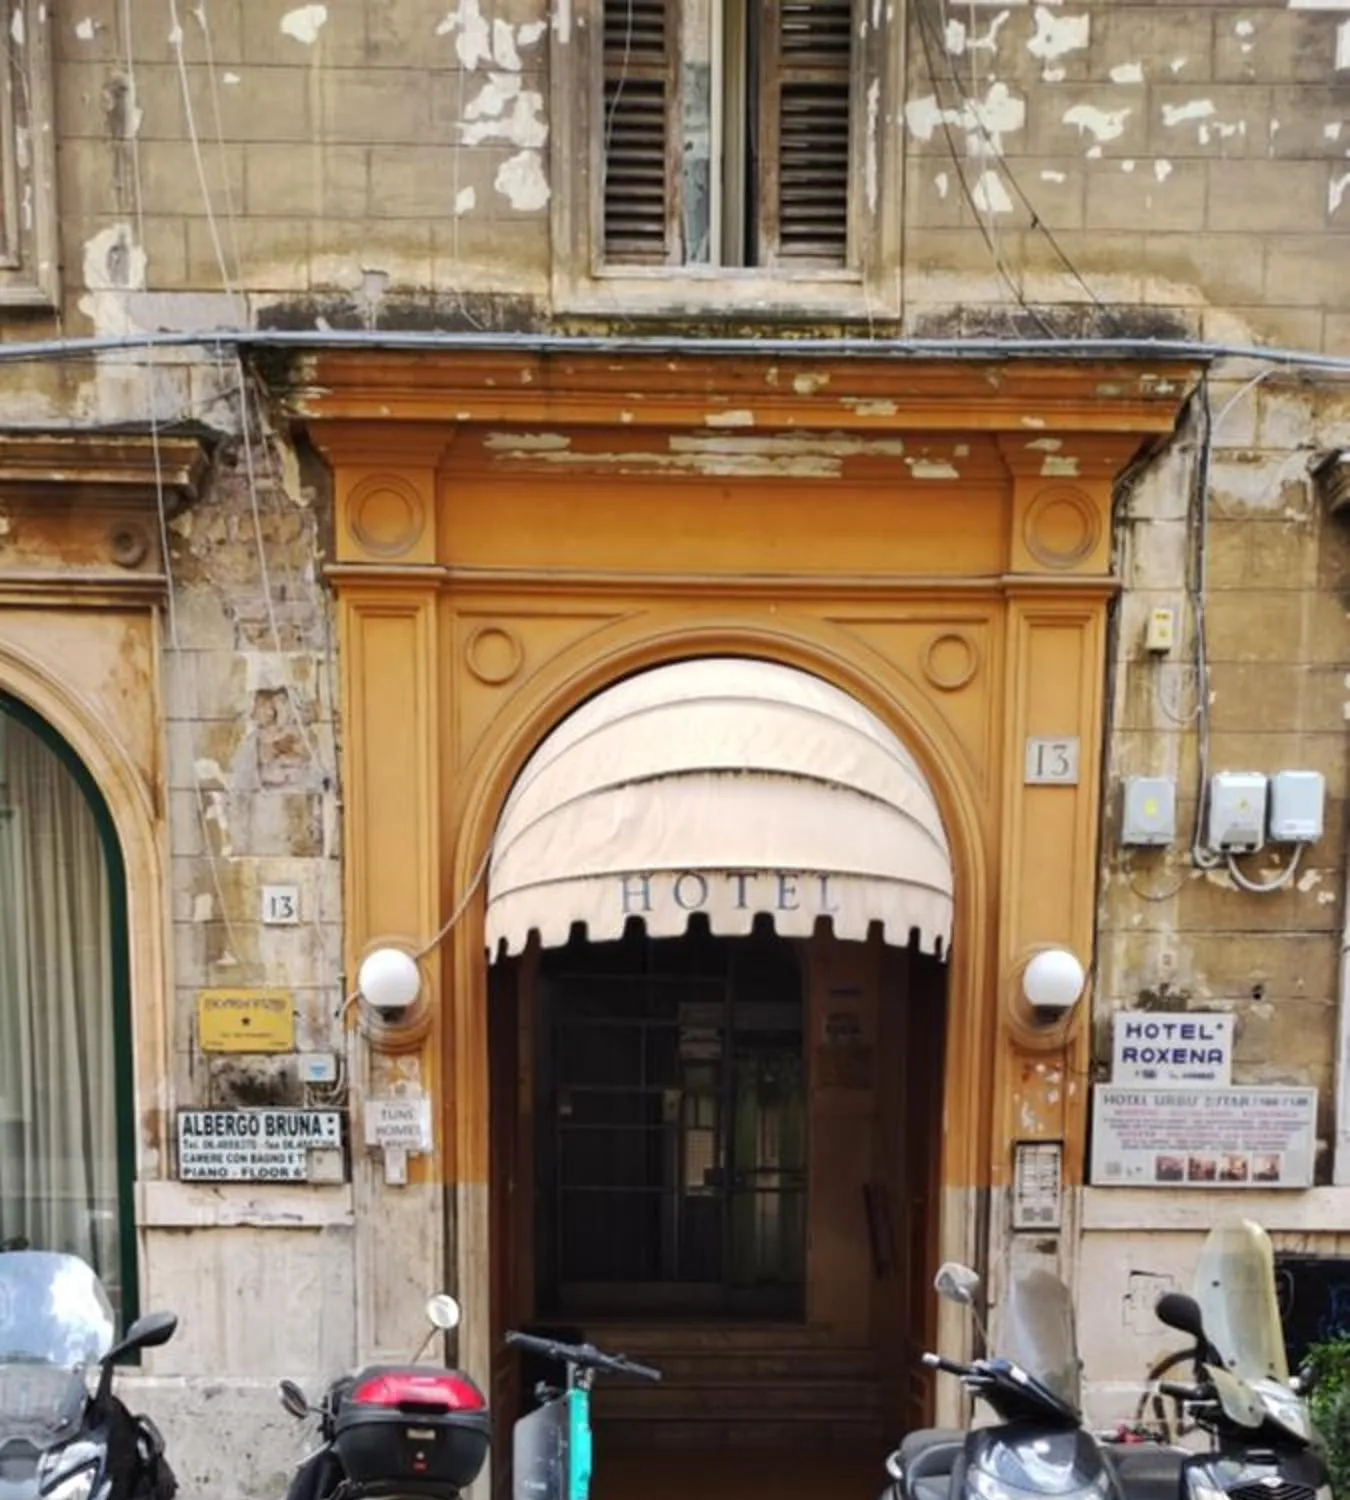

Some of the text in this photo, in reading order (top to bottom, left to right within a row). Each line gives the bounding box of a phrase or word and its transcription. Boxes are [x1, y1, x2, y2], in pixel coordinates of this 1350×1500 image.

[1036, 744, 1069, 776] 13
[620, 868, 841, 913] HOTEL
[270, 895, 294, 919] 13
[1125, 1022, 1214, 1041] HOTEL
[1121, 1047, 1224, 1065] ROXENA
[1103, 1094, 1148, 1107] HOTEL
[183, 1114, 324, 1136] ALBERGO BRUNA
[183, 1152, 224, 1164] CAMERE
[225, 1152, 249, 1164] CON
[251, 1152, 286, 1164] BAGNO
[183, 1166, 229, 1178] PIANO
[240, 1166, 289, 1177] FLOOR
